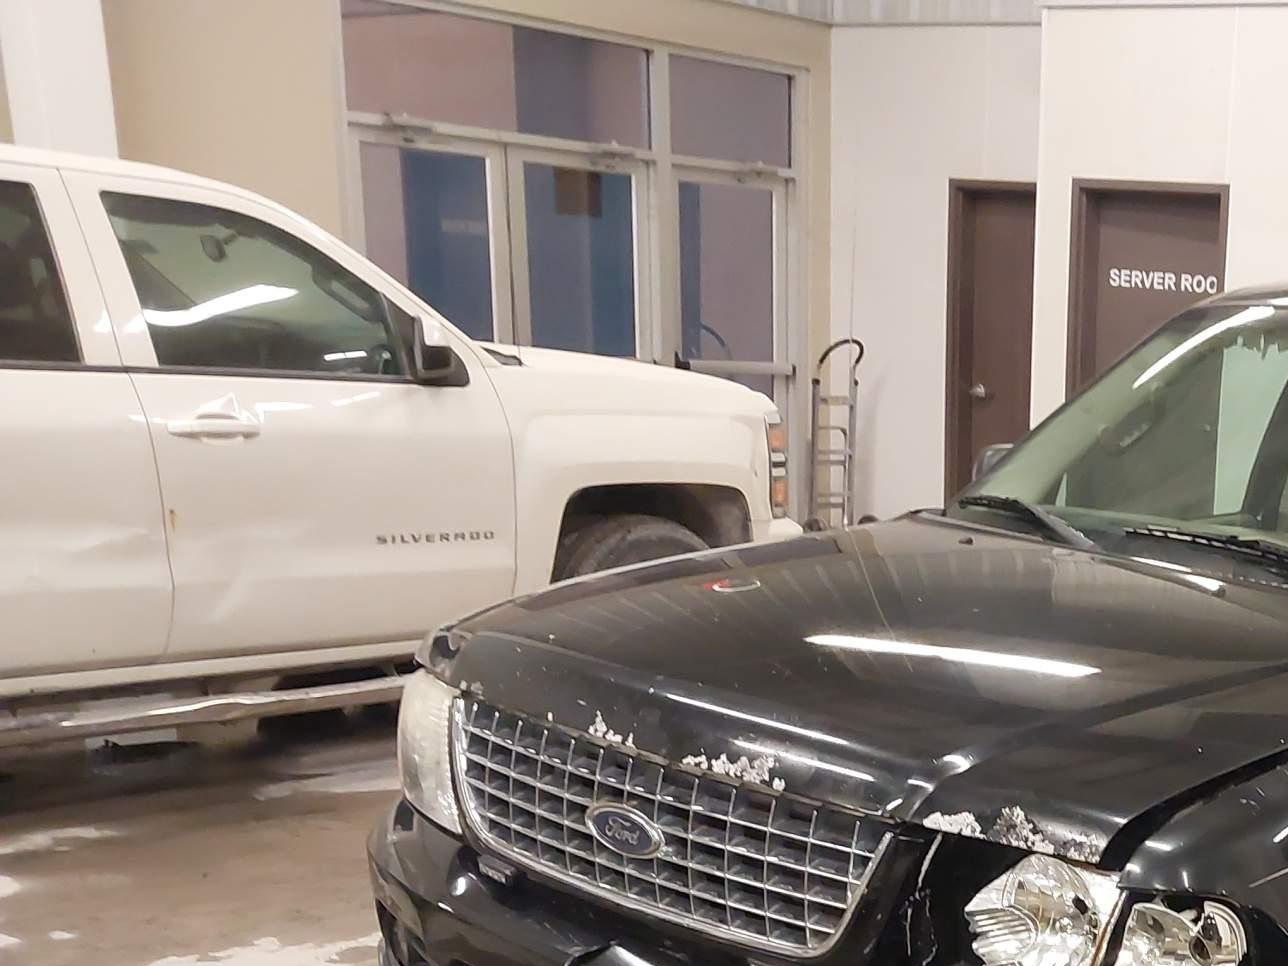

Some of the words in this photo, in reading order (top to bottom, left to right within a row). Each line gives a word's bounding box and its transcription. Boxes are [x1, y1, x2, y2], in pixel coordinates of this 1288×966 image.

[1109, 267, 1177, 292] SERVER
[1180, 273, 1218, 295] ROO
[376, 530, 496, 545] SILVERADO
[605, 816, 640, 846] Ford
